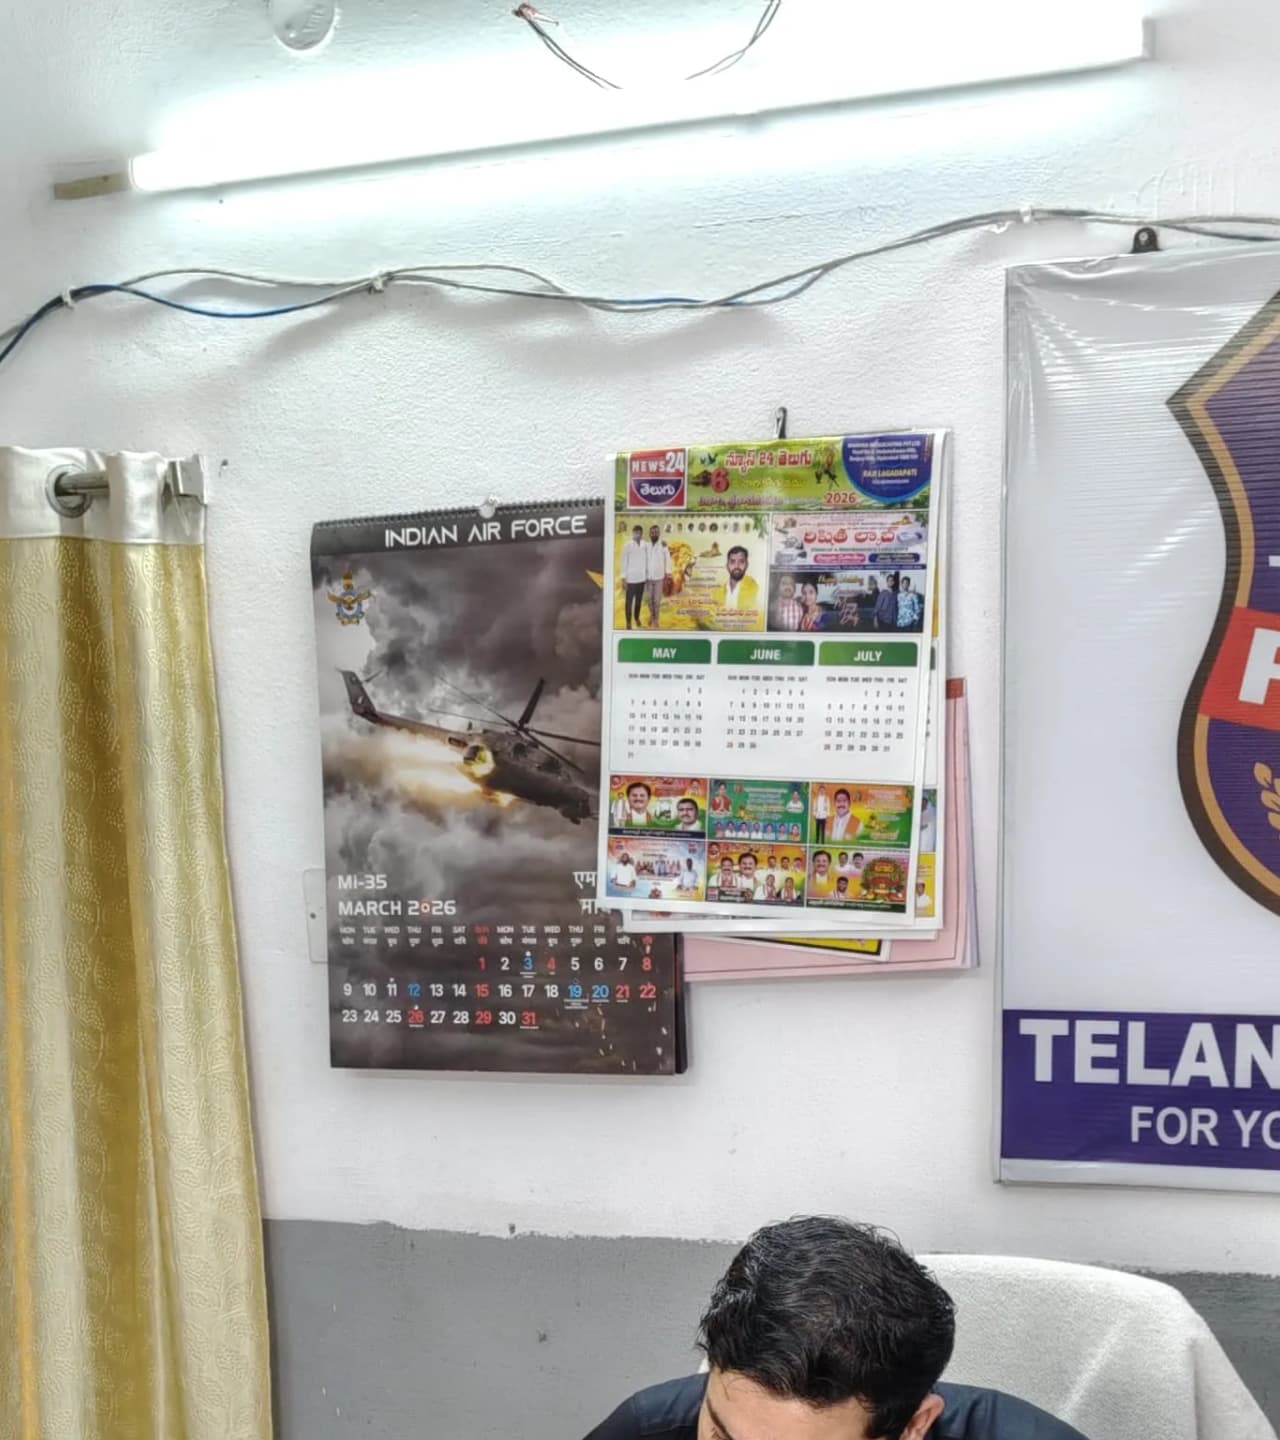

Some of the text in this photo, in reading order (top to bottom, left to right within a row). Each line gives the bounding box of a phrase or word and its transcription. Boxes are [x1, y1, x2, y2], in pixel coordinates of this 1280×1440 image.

[632, 452, 685, 472] NEWS 24
[711, 468, 729, 493] 6
[825, 493, 856, 503] 2026
[385, 515, 587, 547] INDIAN AIR FORCE
[652, 648, 677, 658] MAY
[750, 649, 781, 660] JUNE
[854, 650, 882, 661] JULY
[338, 900, 456, 915] MARCH 2026
[384, 926, 400, 934] WED
[452, 926, 466, 934] SAT
[497, 925, 514, 933] MON
[522, 925, 536, 933] TUE
[544, 925, 560, 933] WED
[568, 925, 583, 933] THU
[594, 925, 605, 933] FRI
[479, 957, 651, 970] 1 2 3 4 5 6 7 8
[343, 983, 656, 998] 9 10 11 12 13 14 15 16 17 18 19 20 21 22
[342, 1010, 536, 1025] 23 24 25 26 27 28 29 30 31
[1130, 1106, 1218, 1146] FOR
